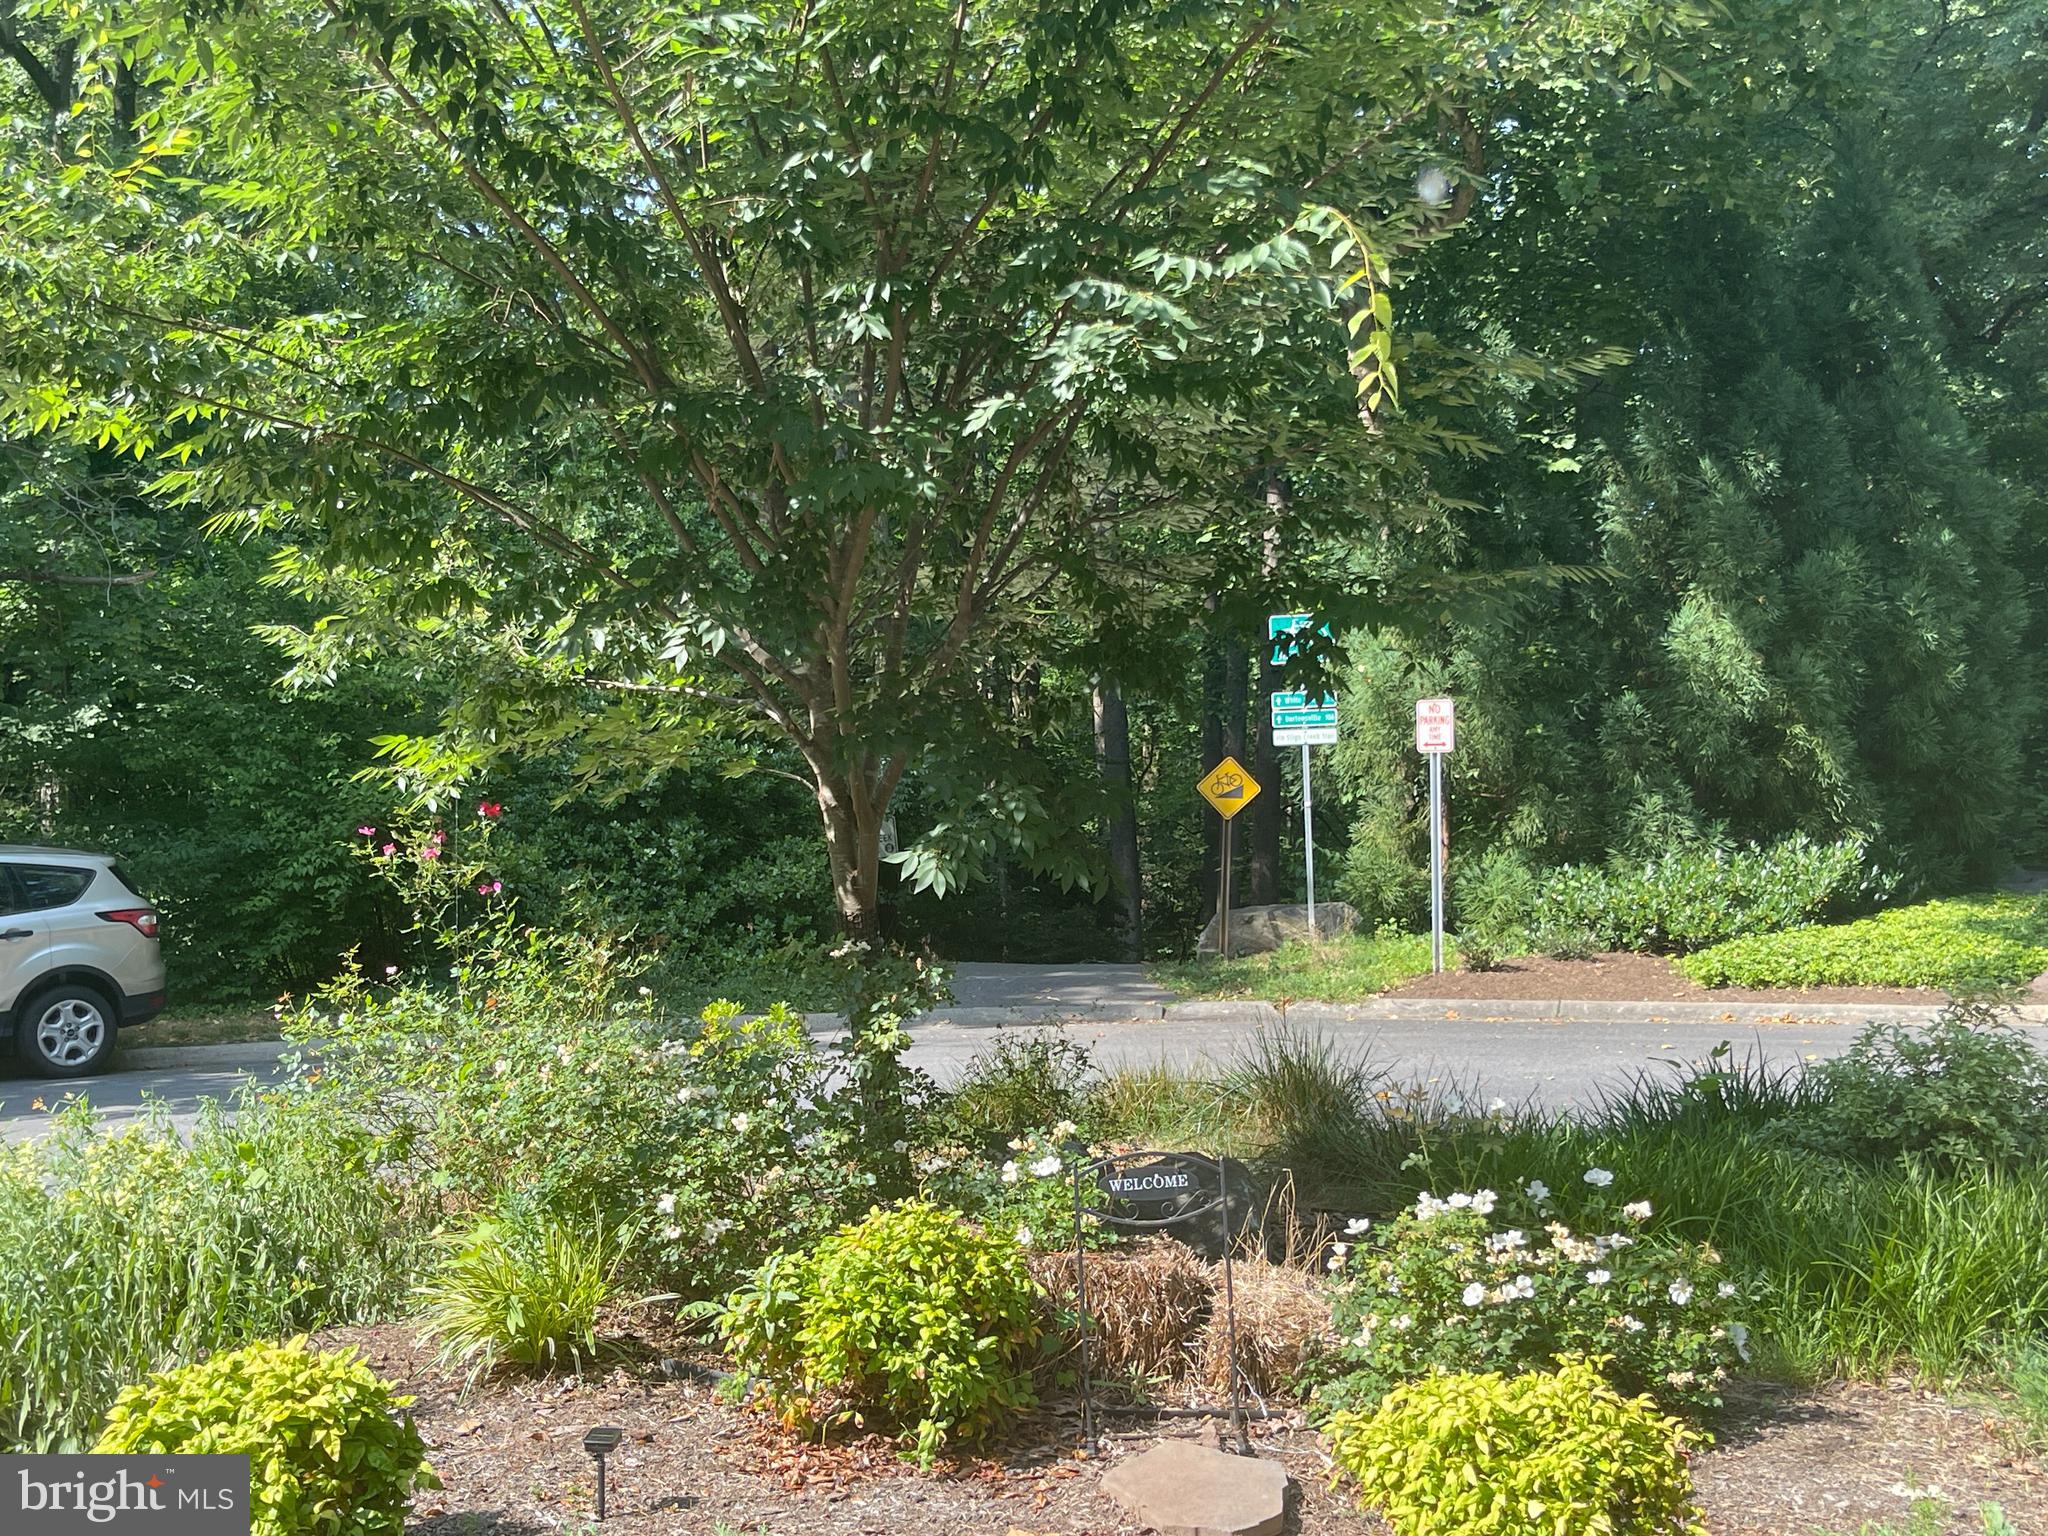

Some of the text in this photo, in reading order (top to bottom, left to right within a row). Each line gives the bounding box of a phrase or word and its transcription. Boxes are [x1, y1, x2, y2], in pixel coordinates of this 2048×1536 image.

[1428, 703, 1441, 714] NO
[1419, 715, 1451, 725] PARKING
[1108, 1173, 1189, 1192] WELCOME
